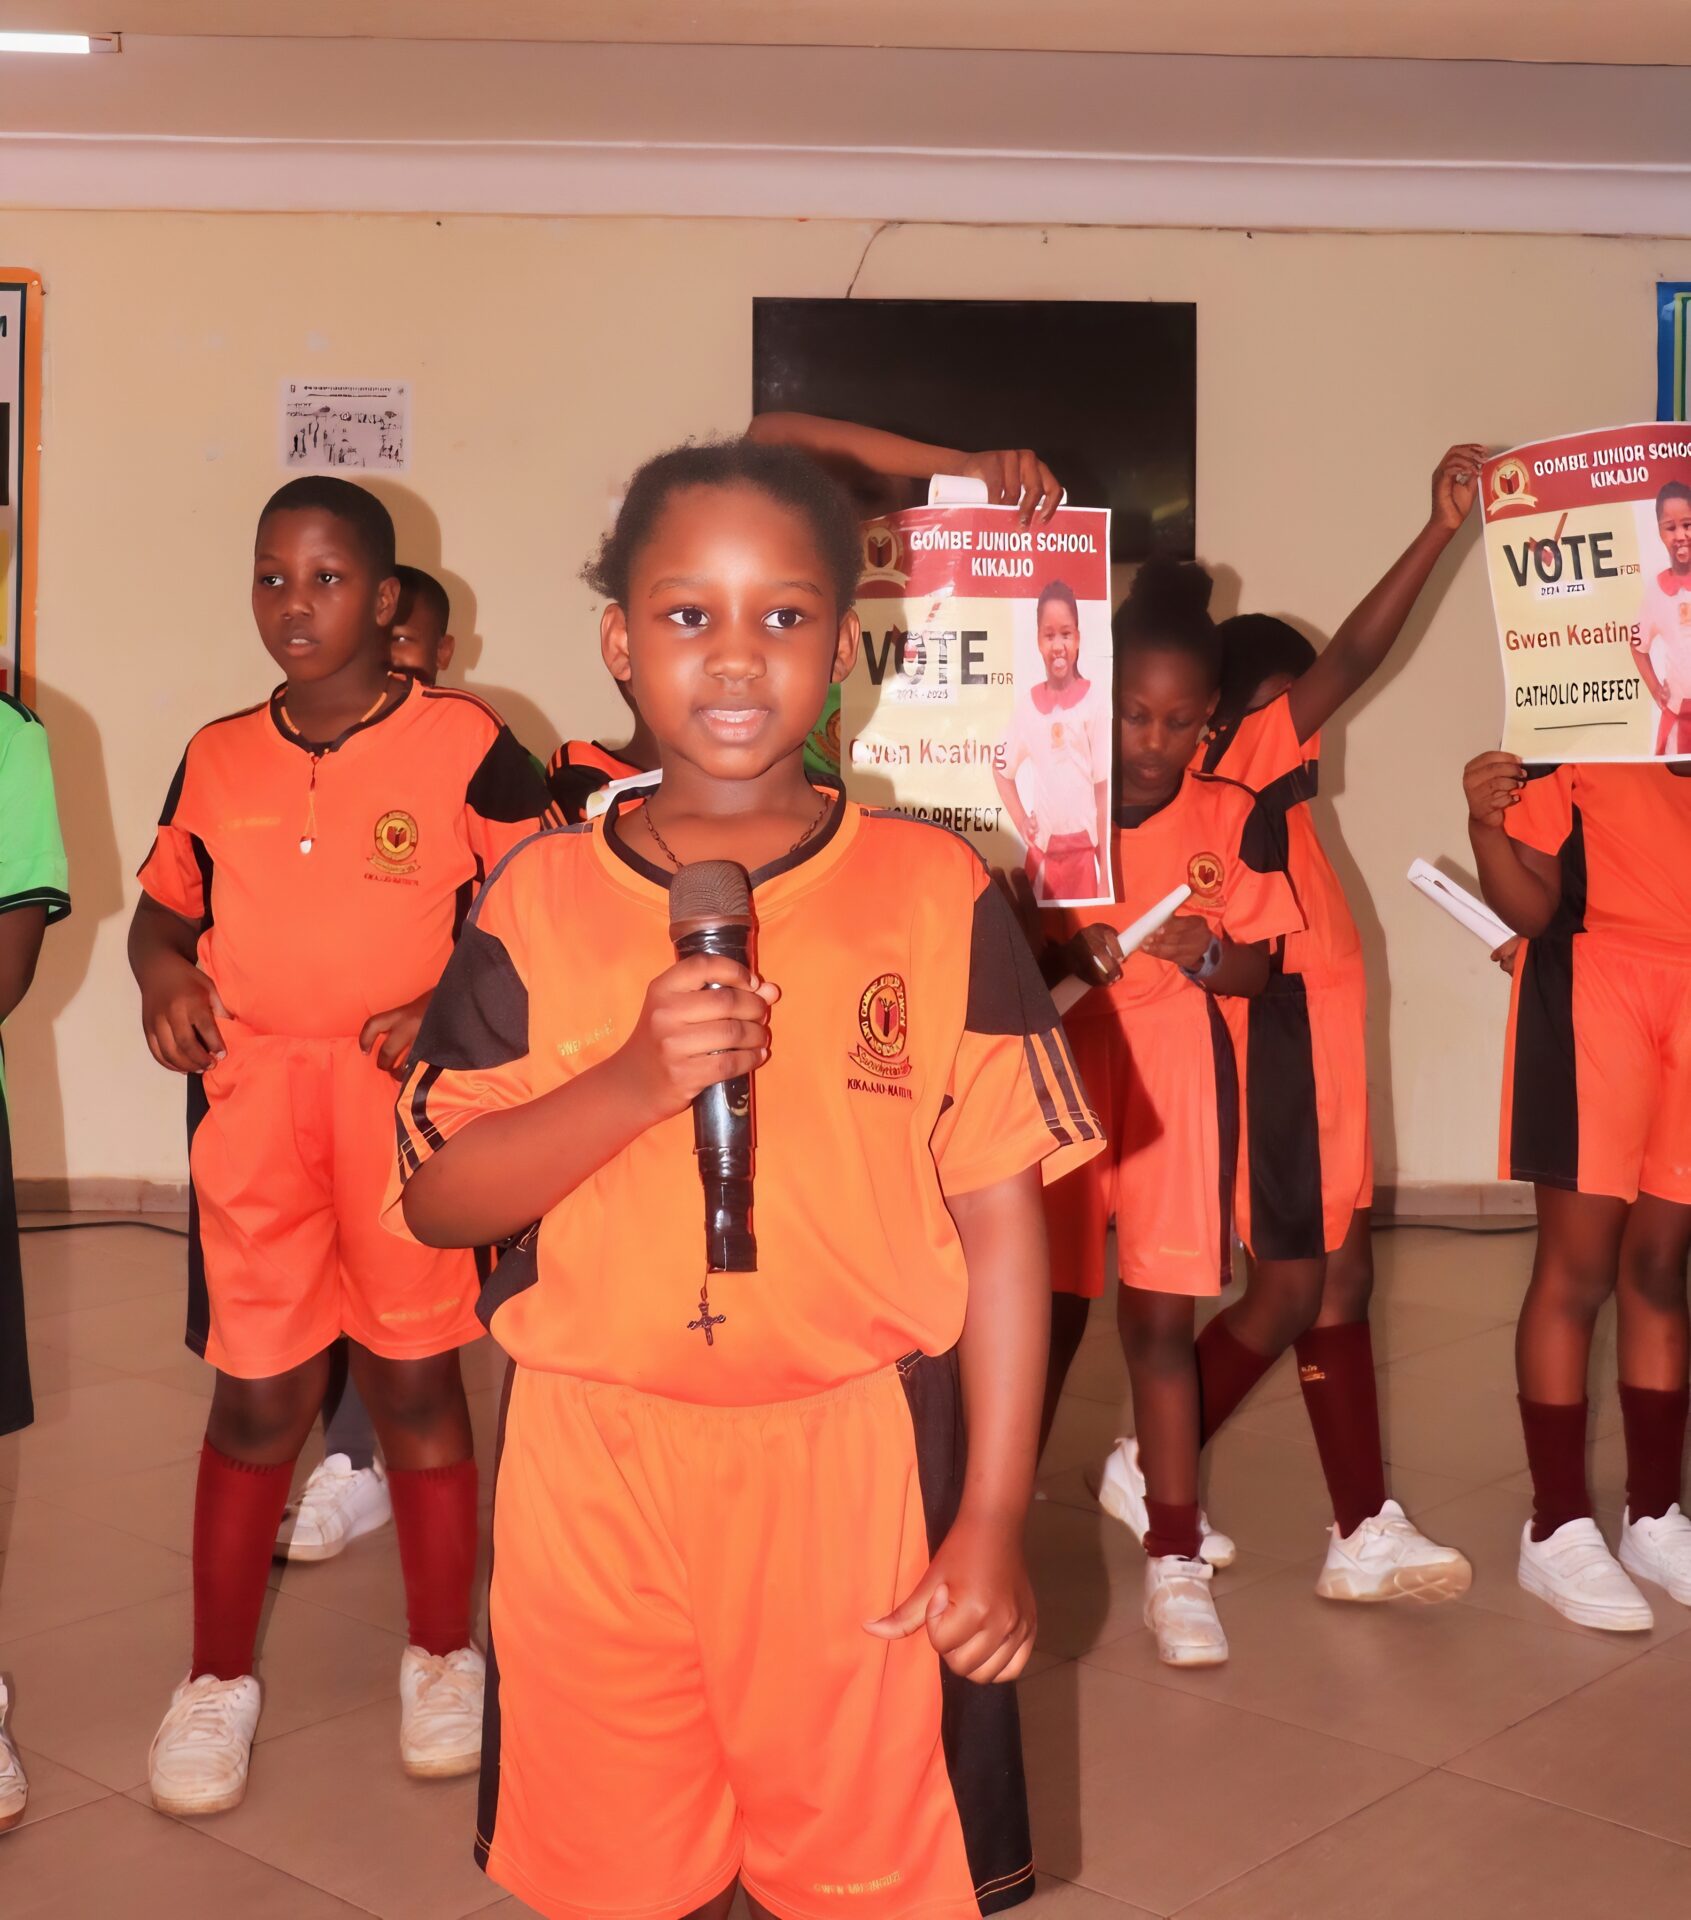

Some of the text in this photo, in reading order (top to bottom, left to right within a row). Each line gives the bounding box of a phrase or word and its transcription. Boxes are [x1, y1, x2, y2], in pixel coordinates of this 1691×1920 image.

[1592, 445, 1646, 468] JUNIOR
[910, 530, 1097, 553] GOMBE JUNIOR SCHOOL
[971, 557, 1034, 578] KIKAJJO
[1503, 531, 1619, 588] VOTE
[1505, 620, 1642, 651] Gwen Keating
[862, 630, 1014, 686] VOTE FOR
[1515, 678, 1640, 707] CATHOLIC PREFECT
[932, 807, 1002, 833] PREFECT
